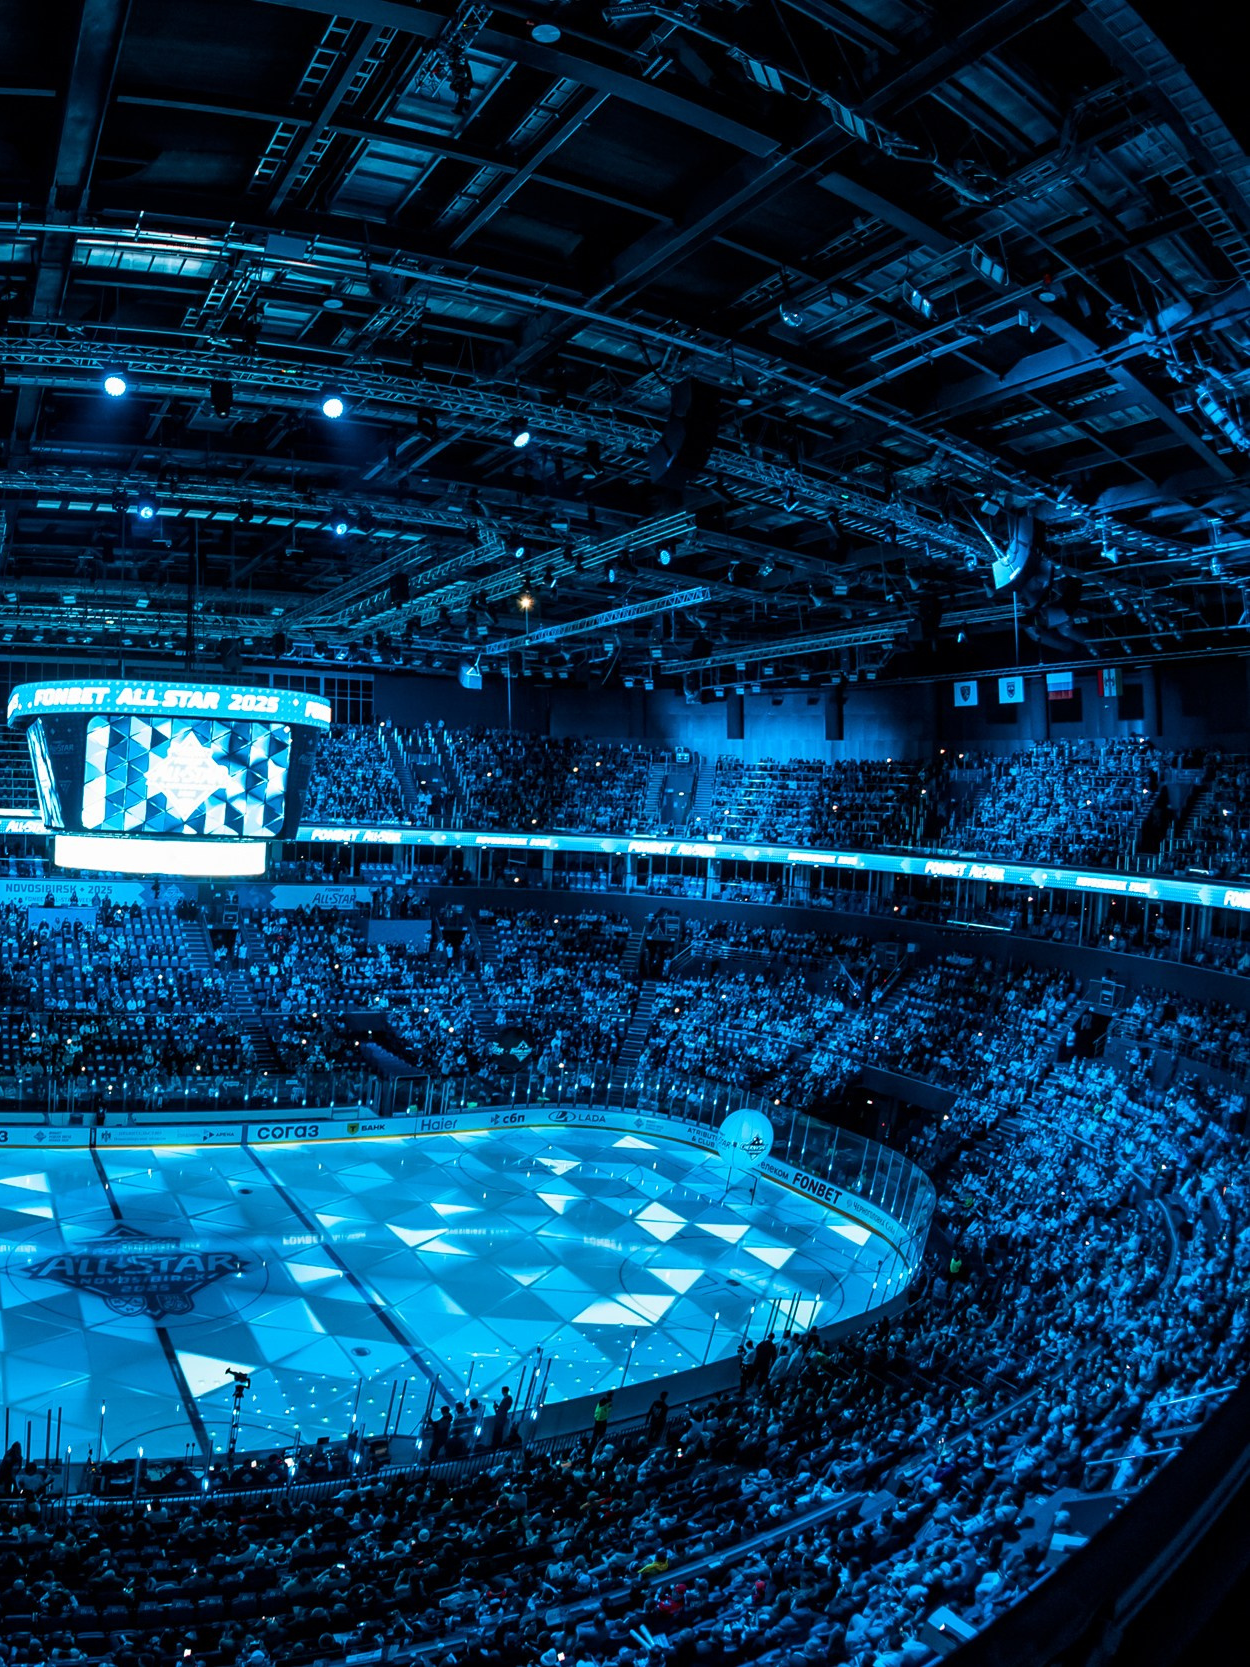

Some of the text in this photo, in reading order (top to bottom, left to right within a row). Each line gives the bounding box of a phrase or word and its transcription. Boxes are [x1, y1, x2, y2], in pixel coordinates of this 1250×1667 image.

[34, 687, 111, 706] FONBET
[227, 694, 280, 713] 2025
[311, 829, 359, 842] FONBET
[5, 884, 113, 894] NOVOSIBIRSK 2025
[502, 1113, 525, 1124] сбп
[579, 1113, 605, 1123] LADA
[362, 1123, 385, 1132] БАНК
[421, 1118, 457, 1131] Haier
[698, 1137, 716, 1148] CLUB
[758, 1161, 789, 1180] елеком
[792, 1172, 843, 1204] FONBET
[80, 1273, 206, 1285] NOVOSIBIRSK
[121, 1284, 170, 1293] 2025
